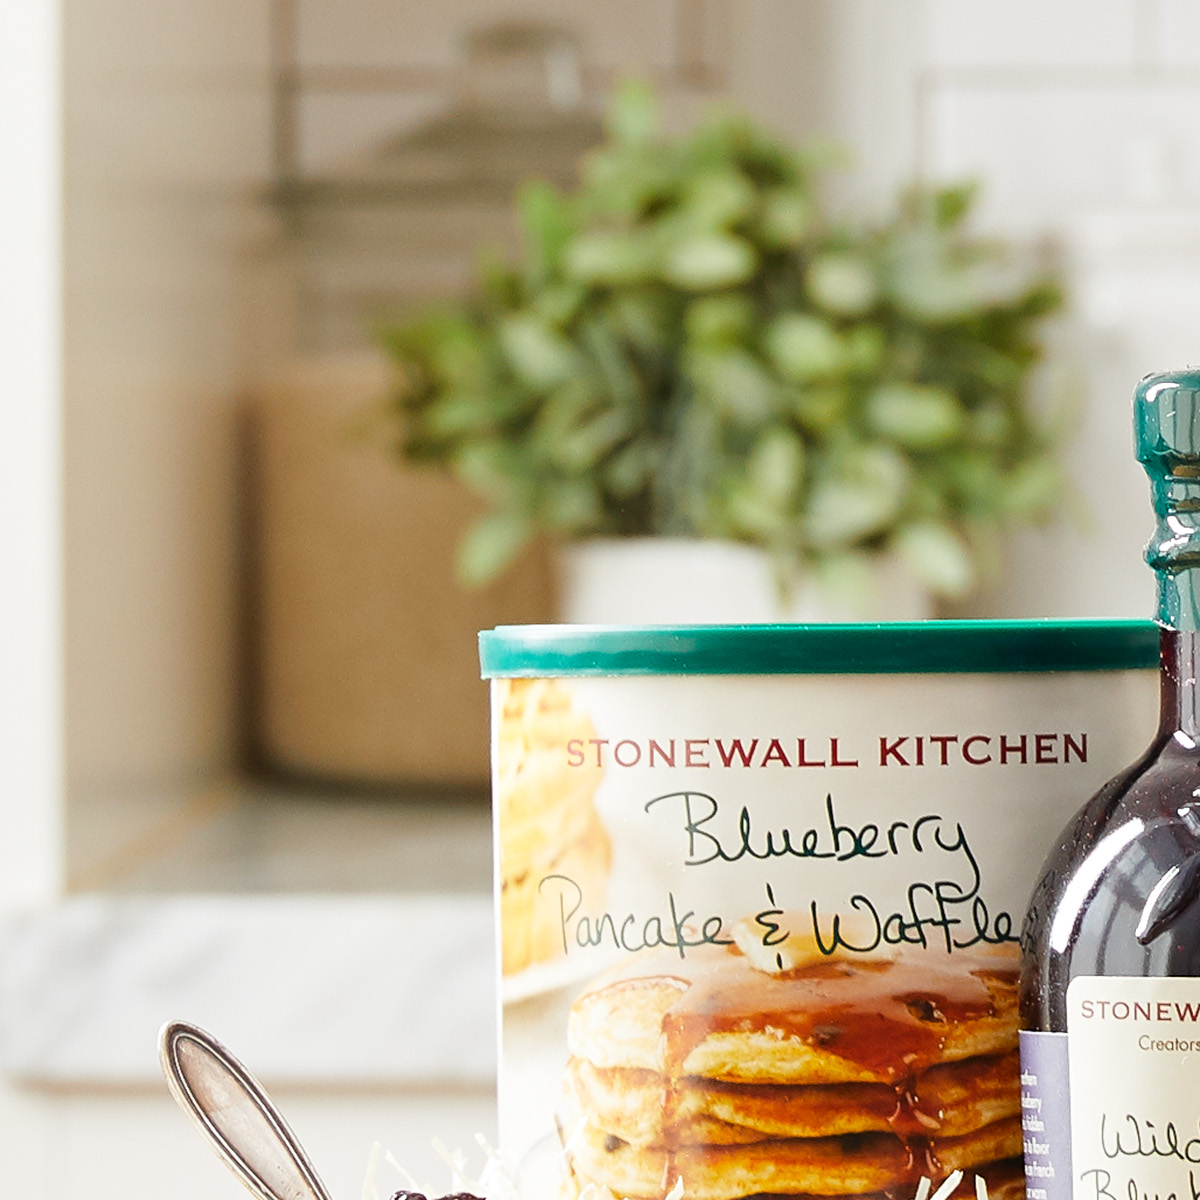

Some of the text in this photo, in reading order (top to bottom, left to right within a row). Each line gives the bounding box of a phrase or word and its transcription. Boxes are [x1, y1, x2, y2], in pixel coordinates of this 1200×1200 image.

[567, 733, 1089, 769] STONEWALL KITCHEN
[645, 791, 980, 902] Blueberry
[538, 875, 1021, 970] Pancake & Waffle
